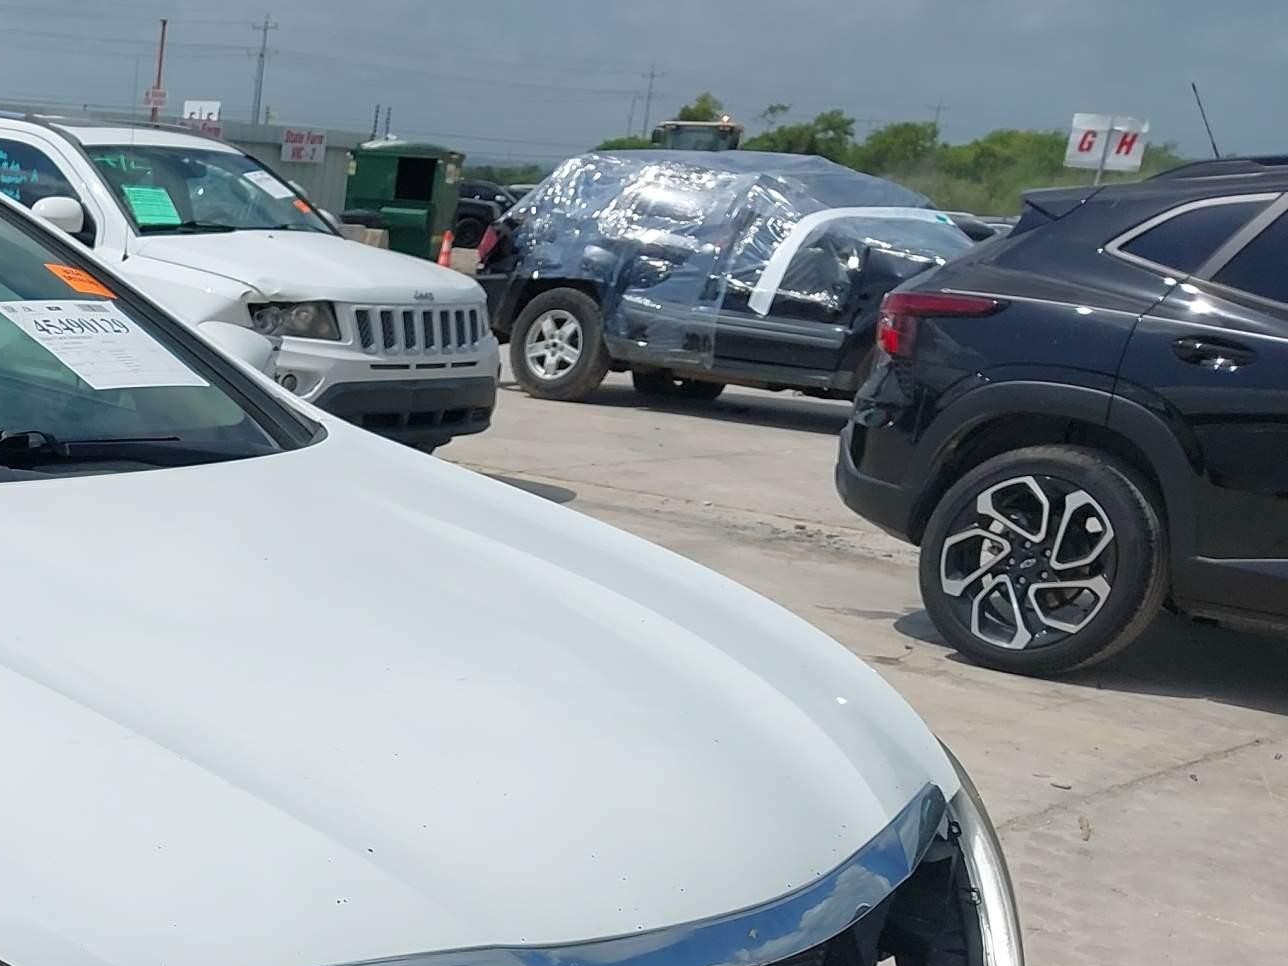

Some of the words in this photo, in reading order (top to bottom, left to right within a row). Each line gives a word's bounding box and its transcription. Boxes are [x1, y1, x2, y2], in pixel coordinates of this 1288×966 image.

[1078, 129, 1097, 152] G
[1115, 132, 1139, 155] H
[33, 318, 130, 335] 45490129
